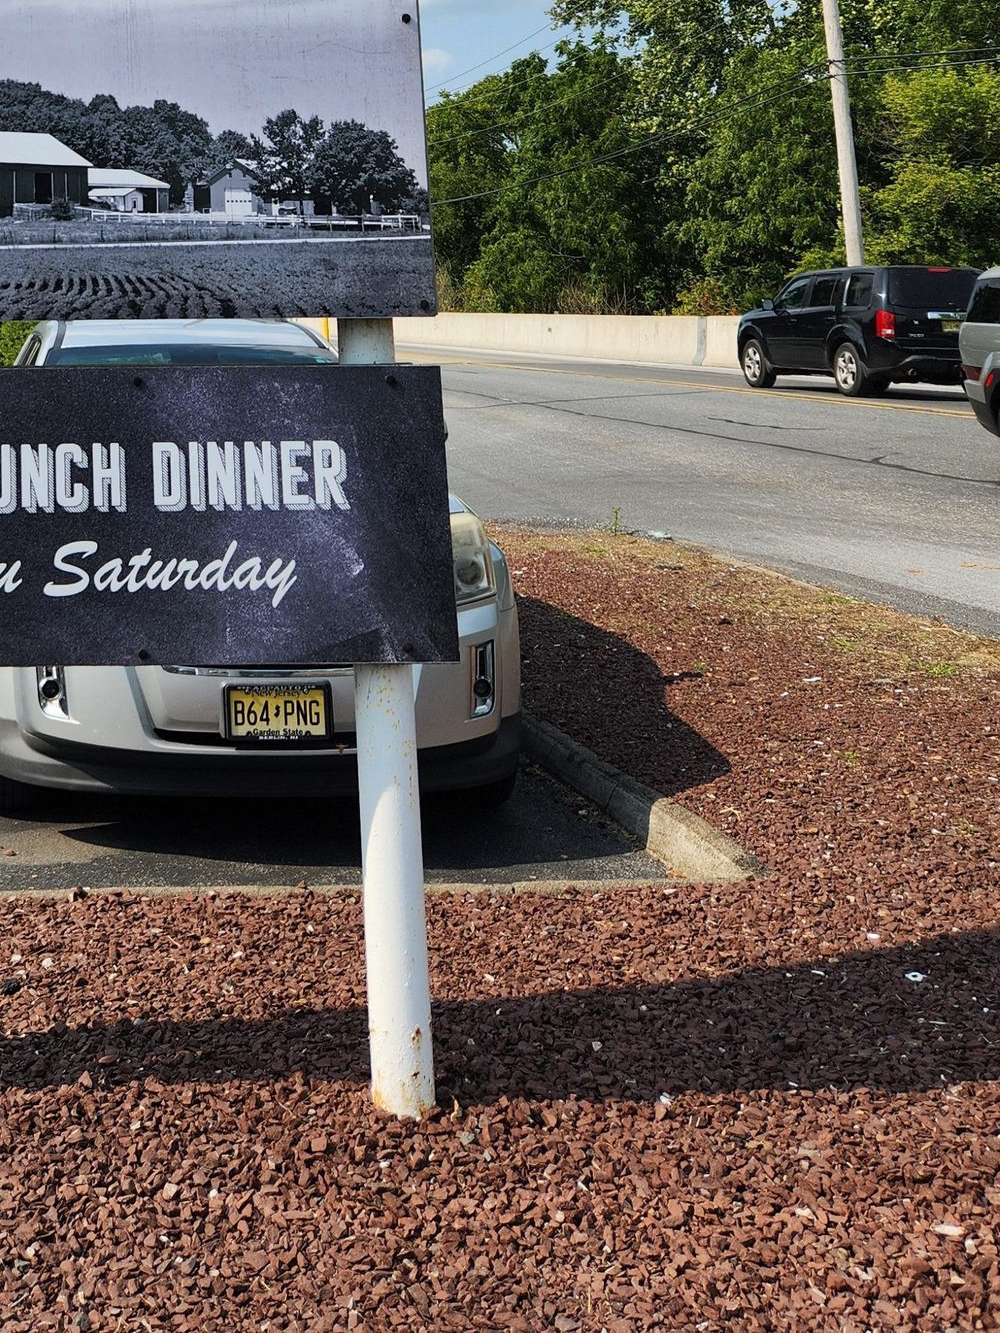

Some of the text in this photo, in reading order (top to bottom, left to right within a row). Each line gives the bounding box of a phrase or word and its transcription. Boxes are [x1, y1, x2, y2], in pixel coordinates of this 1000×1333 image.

[152, 440, 351, 511] DINNER
[42, 540, 299, 608] Saturday
[251, 689, 301, 699] New Jersey
[233, 700, 320, 726] B64 PNG
[252, 728, 304, 736] Garden State
